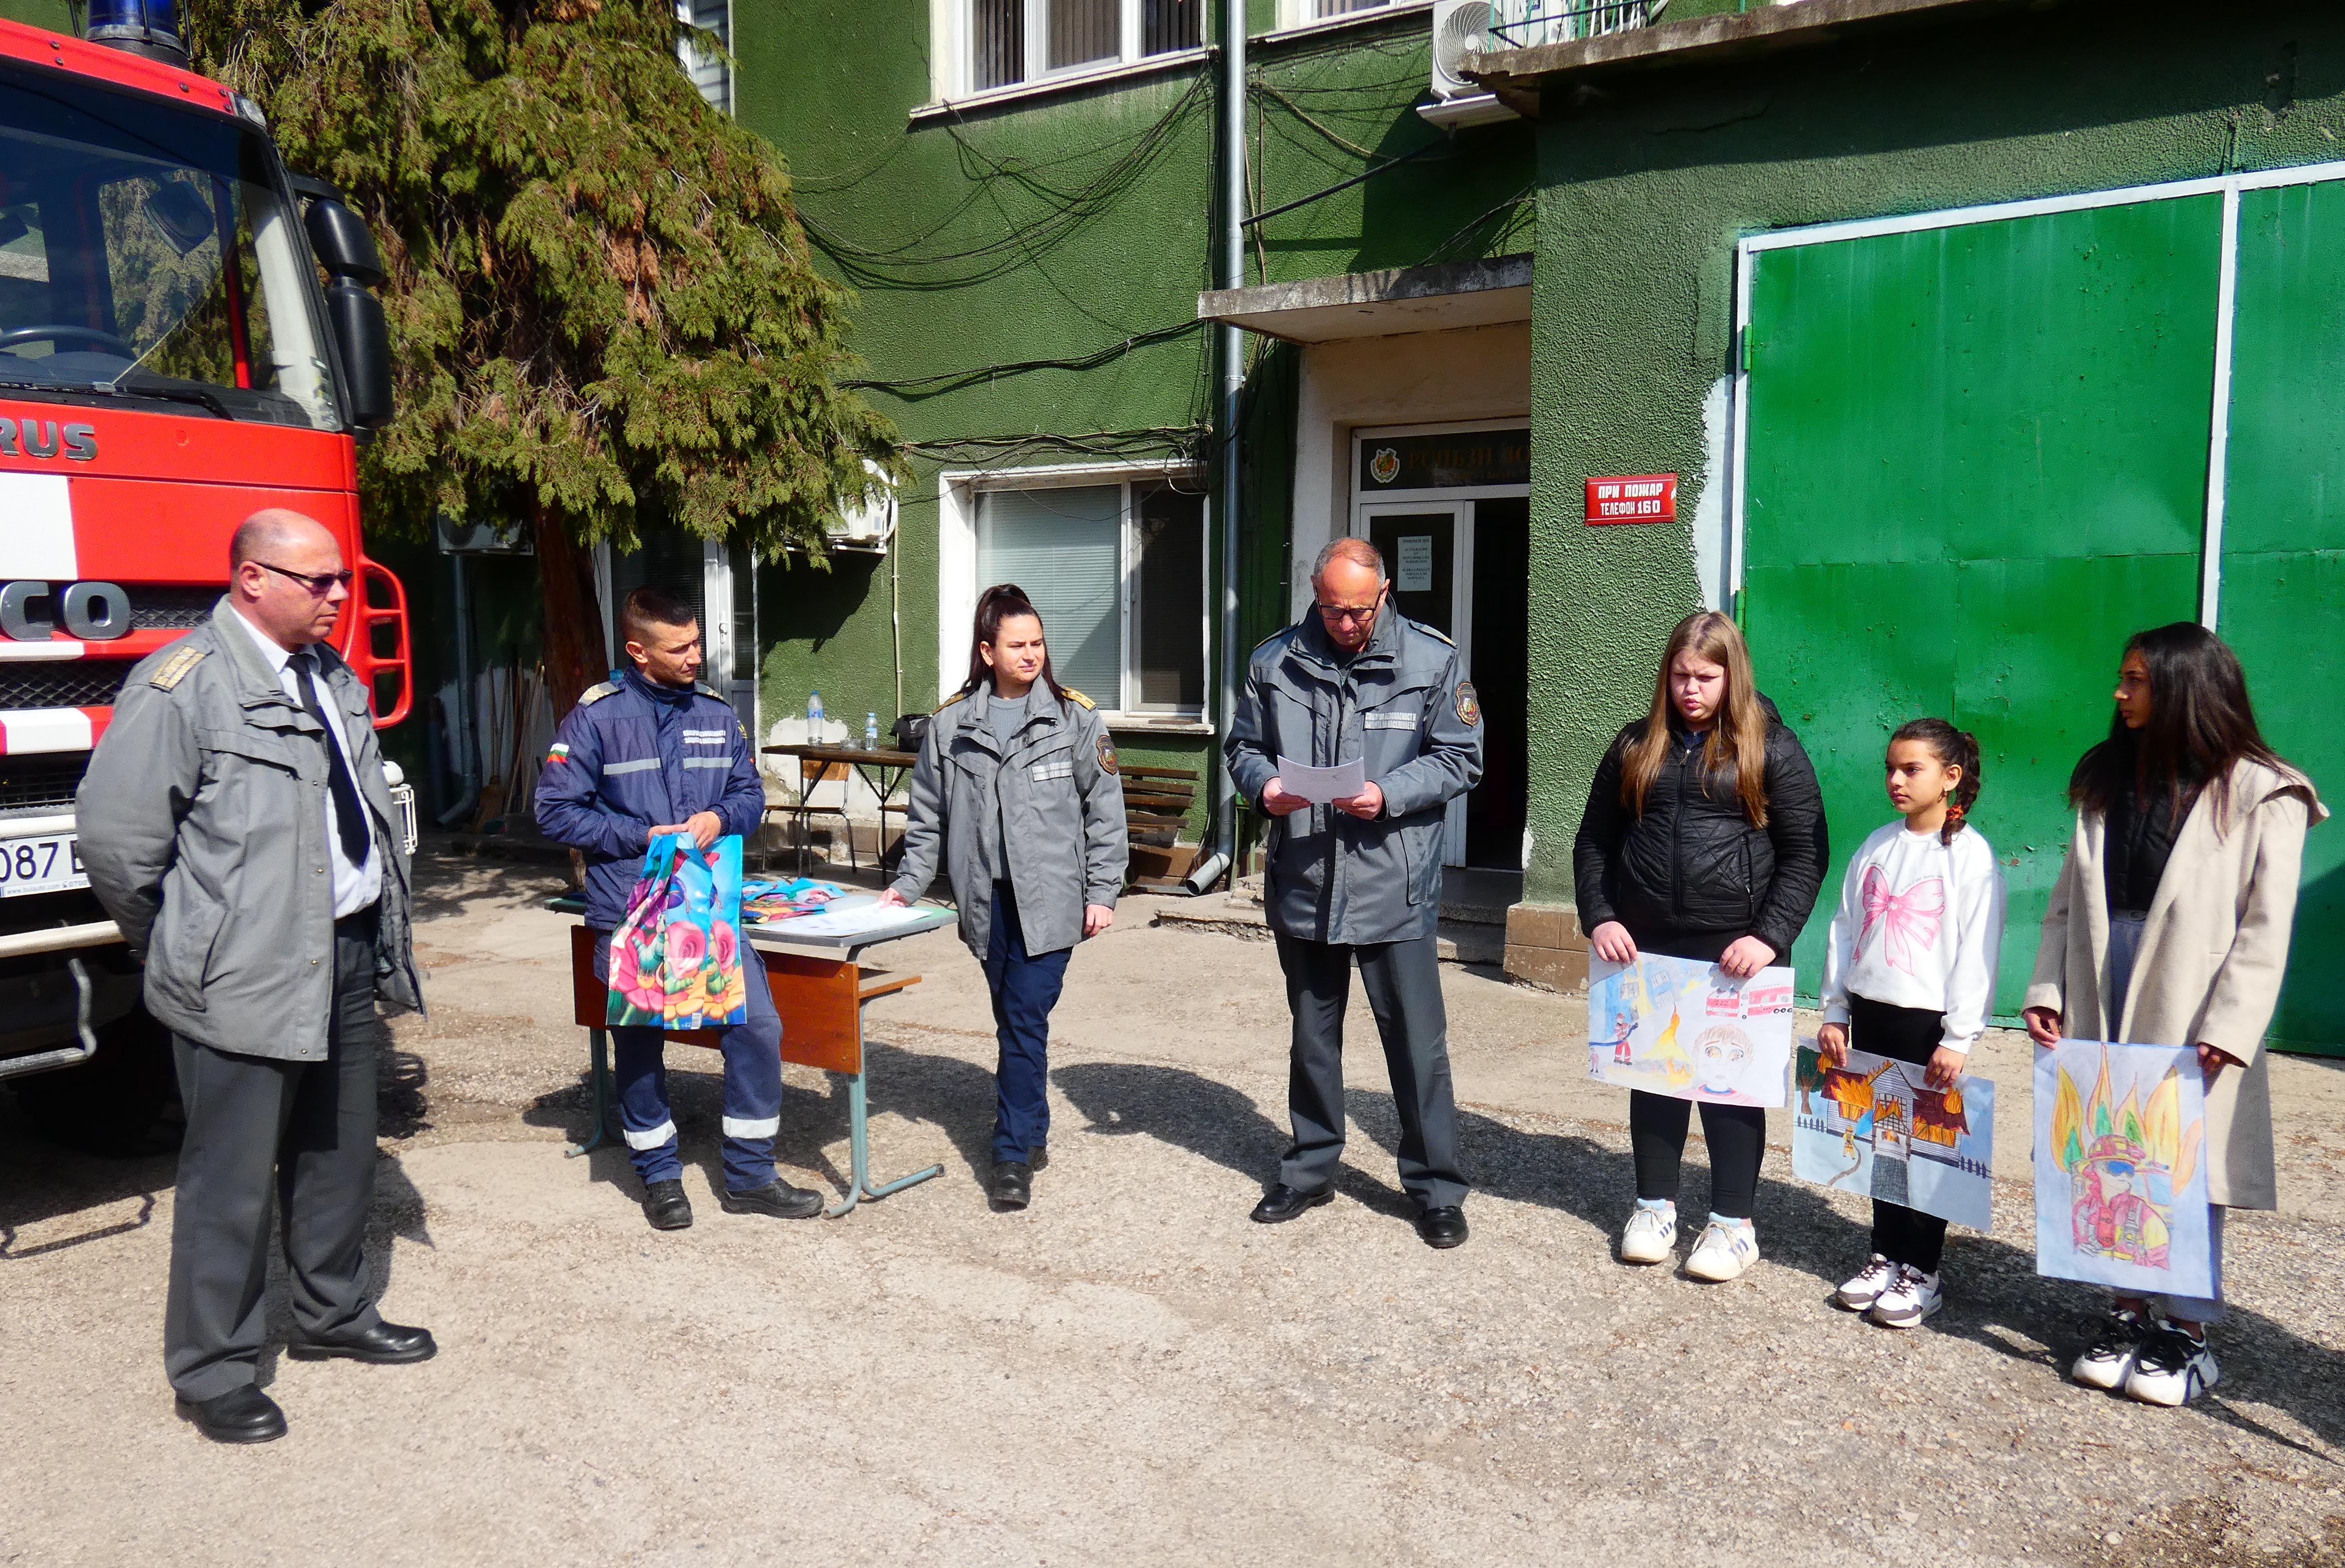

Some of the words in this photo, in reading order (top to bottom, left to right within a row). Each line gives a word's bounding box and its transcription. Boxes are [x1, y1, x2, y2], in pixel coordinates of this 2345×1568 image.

[1598, 485, 1620, 499] ПРИ
[1625, 483, 1663, 498] ПОЖАР
[1600, 501, 1635, 516] ТЕЛЕФОН
[1637, 500, 1660, 514] 160
